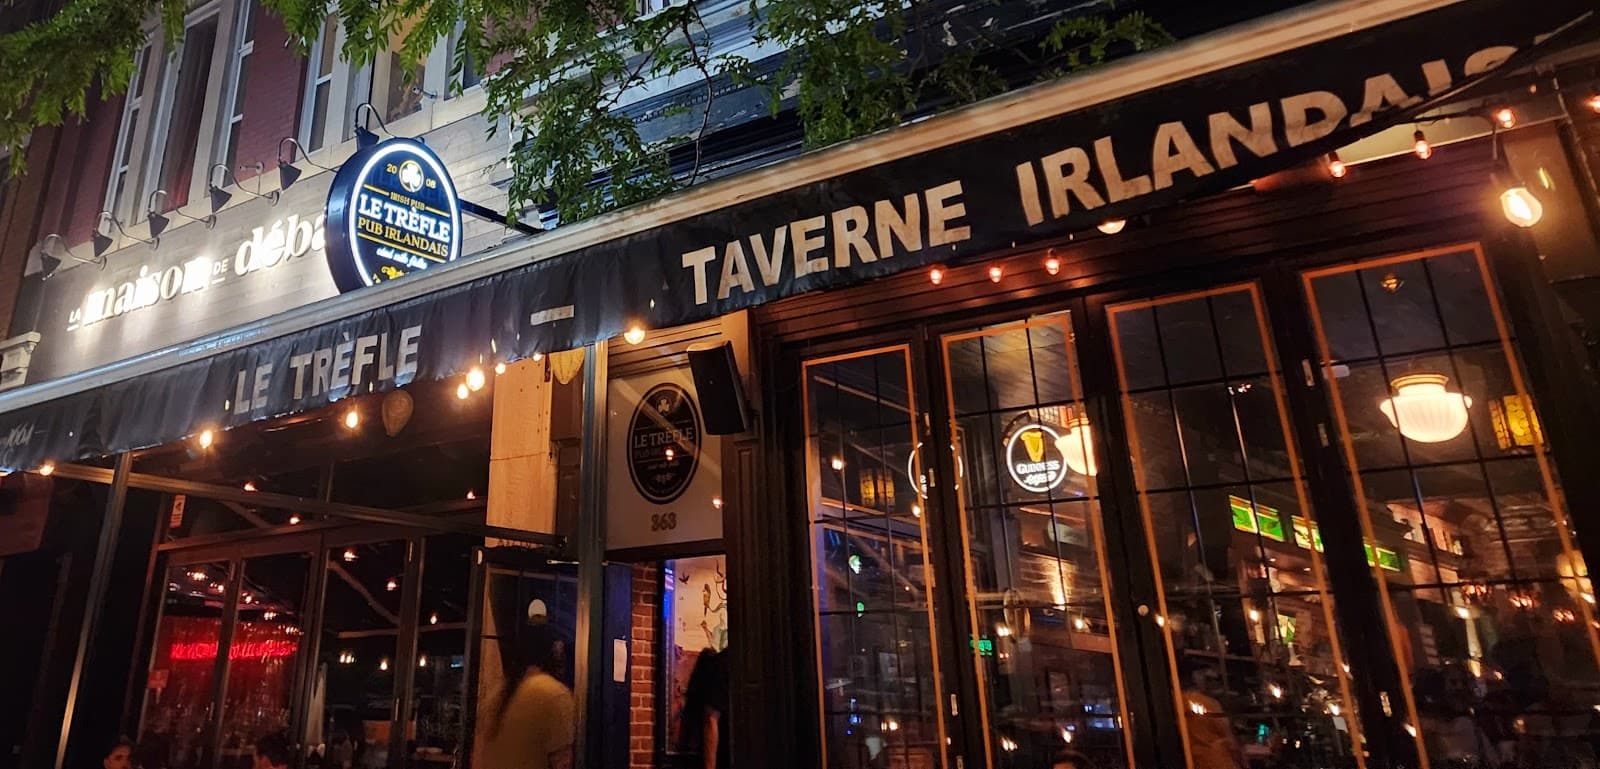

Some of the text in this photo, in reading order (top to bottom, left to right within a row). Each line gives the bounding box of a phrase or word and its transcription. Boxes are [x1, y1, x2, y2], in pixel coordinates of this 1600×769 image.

[386, 163, 398, 174] 20
[358, 194, 450, 243] LE TRÈFLE
[390, 192, 426, 211] IRISH PUB
[357, 216, 449, 257] PUB IRLANDAIS
[83, 255, 212, 327] maison
[212, 258, 229, 276] DE
[233, 362, 273, 416] LE
[289, 325, 423, 403] TRÈFLE
[682, 180, 971, 305] TAVERNE
[634, 434, 648, 449] LE
